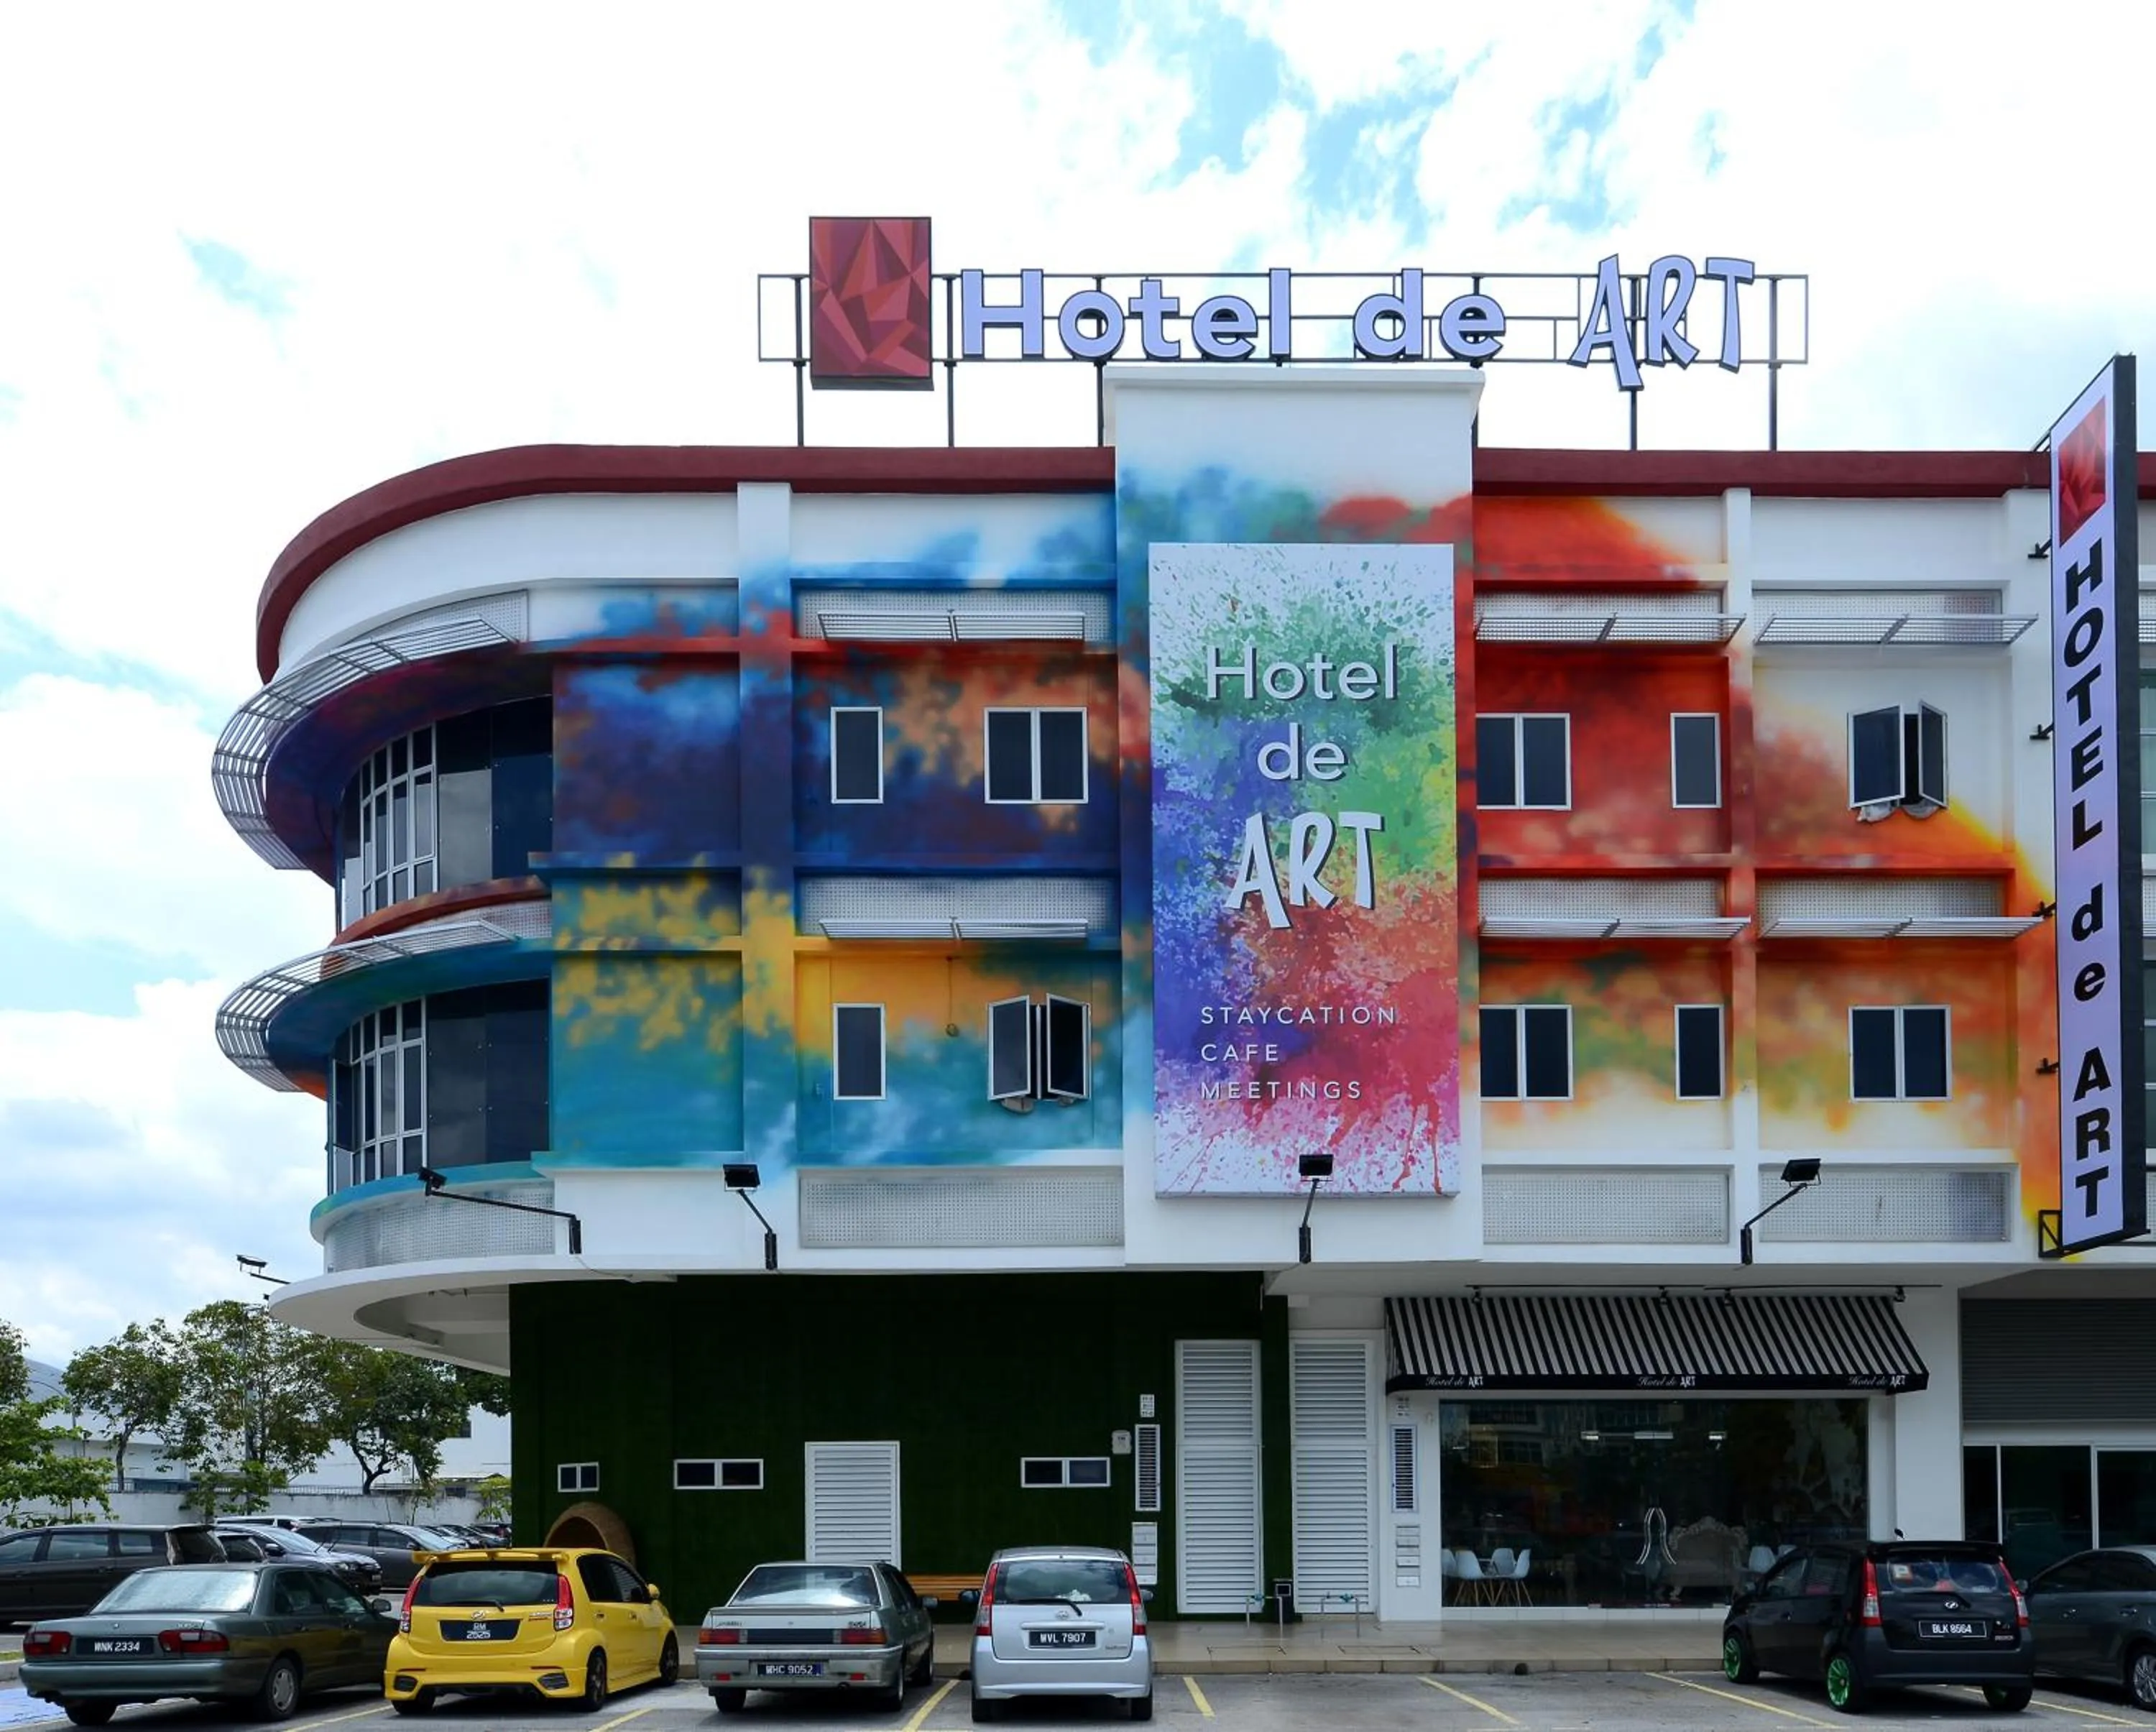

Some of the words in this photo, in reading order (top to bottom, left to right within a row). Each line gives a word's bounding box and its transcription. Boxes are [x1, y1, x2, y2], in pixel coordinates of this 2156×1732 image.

[961, 268, 1291, 360] Hotel
[1353, 268, 1506, 360] de
[1567, 254, 1755, 391] ART
[1206, 644, 1399, 701] Hotel
[2063, 537, 2105, 851] HOTEL
[1257, 722, 1348, 781] de
[1223, 811, 1386, 930] ART
[2071, 883, 2106, 1002] de
[1200, 1006, 1399, 1026] STAYCATION
[1200, 1044, 1280, 1062] CAFE
[1200, 1081, 1363, 1100] MEETINGS
[2073, 1046, 2112, 1218] ART
[1468, 1376, 1484, 1388] ART
[1680, 1376, 1696, 1388] ART
[1889, 1374, 1906, 1388] ART
[1931, 1623, 1949, 1634] BLK
[93, 1641, 113, 1652] WNK
[114, 1641, 141, 1652] 2334
[1039, 1633, 1059, 1644] WVL
[788, 1664, 814, 1675] 9052
